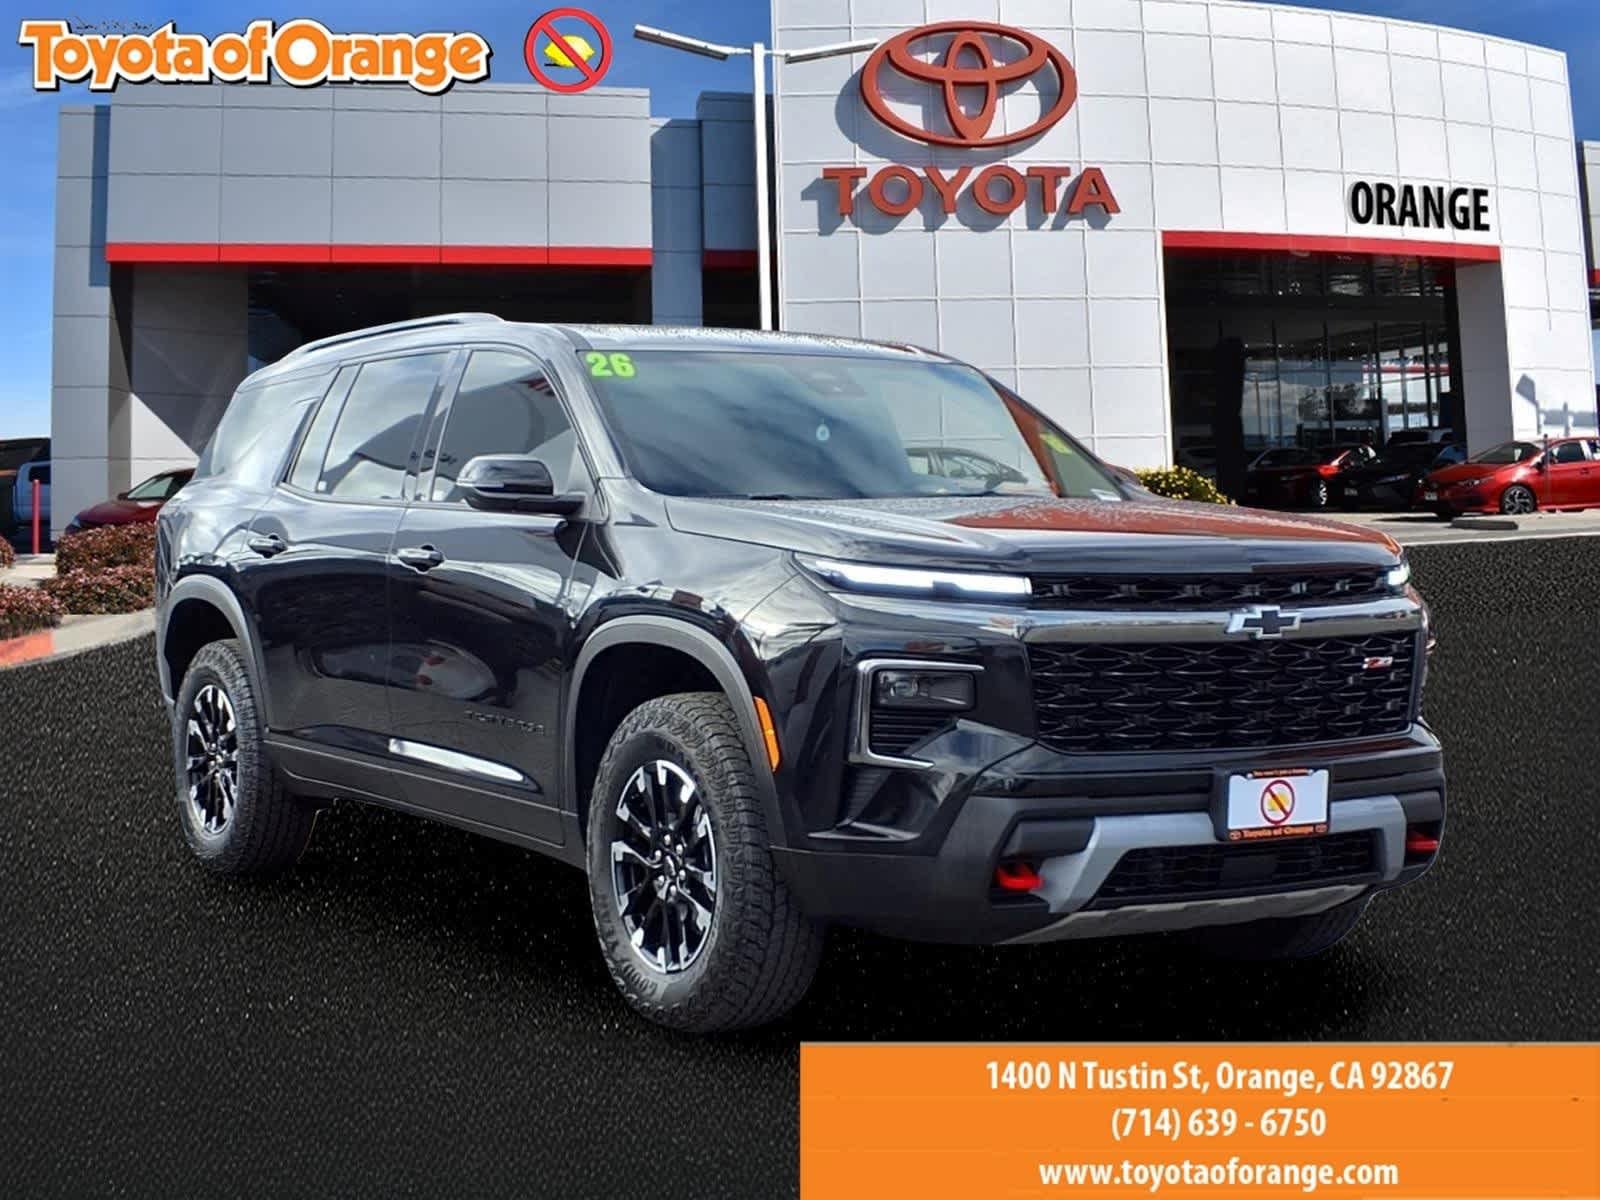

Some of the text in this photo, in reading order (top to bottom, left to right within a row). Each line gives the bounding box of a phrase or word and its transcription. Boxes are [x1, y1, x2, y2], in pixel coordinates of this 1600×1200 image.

[823, 165, 1120, 217] TOYOTA
[1350, 180, 1491, 232] ORANGE
[586, 352, 636, 378] 26
